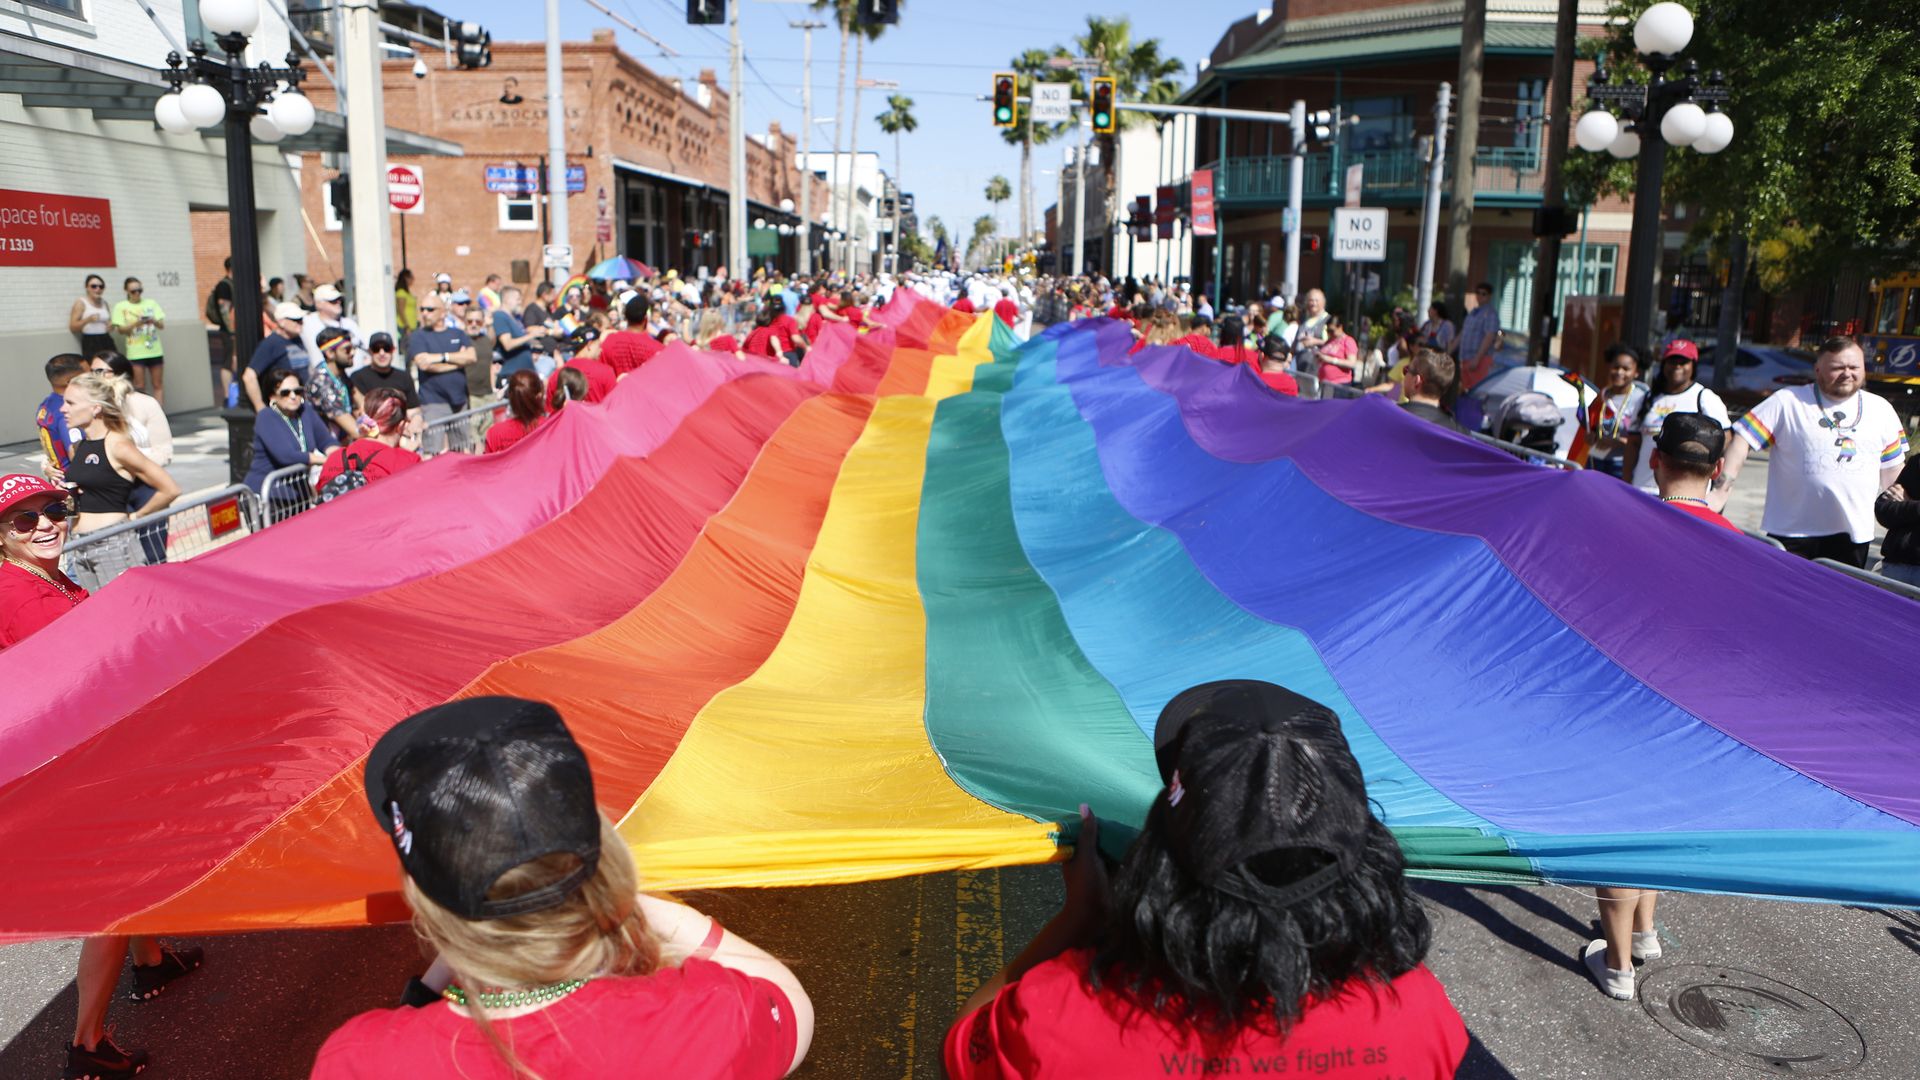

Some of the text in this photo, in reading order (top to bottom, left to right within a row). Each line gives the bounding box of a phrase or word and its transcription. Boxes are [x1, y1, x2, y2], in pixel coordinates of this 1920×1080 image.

[1042, 89, 1060, 101] NO
[1035, 105, 1069, 115] TURNS
[0, 204, 101, 229] pace for Lease
[1350, 218, 1372, 231] NO
[10, 239, 34, 251] 1319
[1339, 239, 1381, 251] TURNS
[157, 271, 180, 287] 1228
[1160, 1045, 1389, 1075] When we fight as
